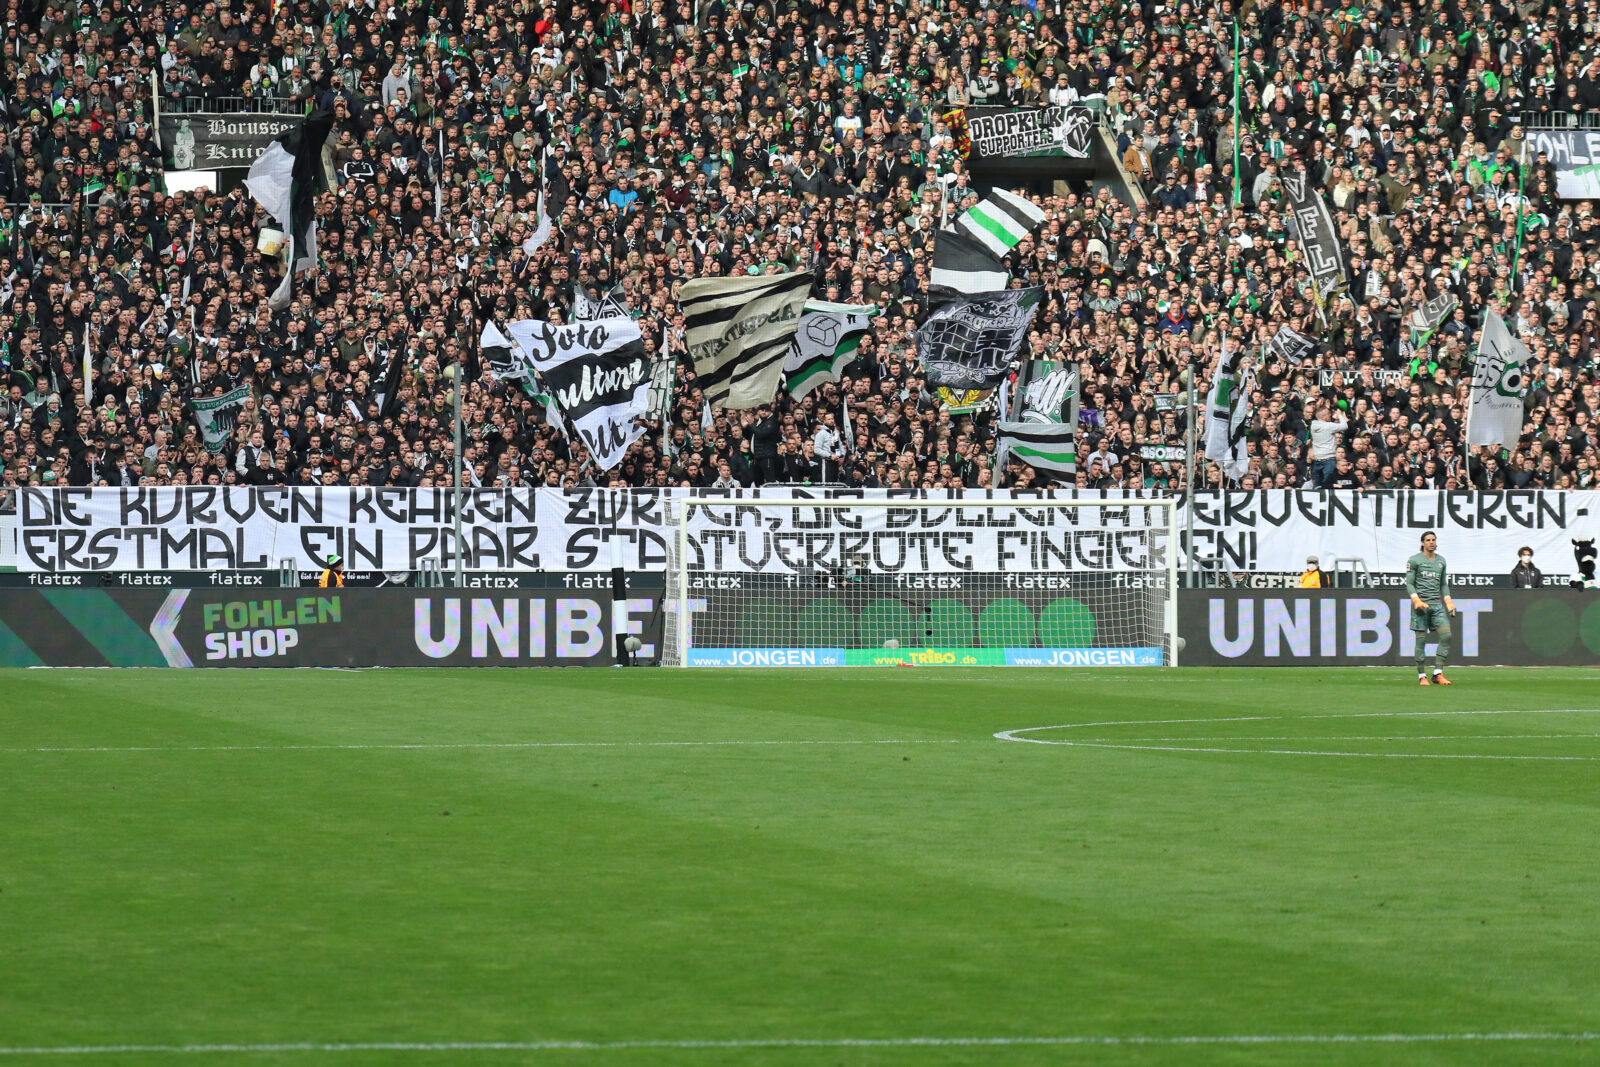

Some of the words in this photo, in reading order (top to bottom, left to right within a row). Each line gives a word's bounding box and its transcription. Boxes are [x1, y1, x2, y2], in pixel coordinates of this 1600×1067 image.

[206, 119, 296, 138] Borusse
[969, 107, 1061, 141] DROPKIK
[1322, 370, 1402, 386] MALHER
[22, 487, 92, 526] DIE
[120, 486, 322, 525] KURVEN
[349, 487, 535, 524] KEHREN
[791, 489, 864, 529] DIE
[886, 489, 1078, 529] BULLEN
[1100, 489, 1566, 529] HYPERVENTILIEREN
[23, 527, 267, 571] ERSTMAL
[300, 526, 382, 570] EIN
[409, 526, 540, 570] PAAR
[566, 527, 973, 572] STADTVERBOTE
[997, 530, 1257, 571] FINGIEREN!
[28, 574, 81, 585] flatex
[119, 574, 172, 585] flatex
[209, 573, 262, 585] flatex
[894, 574, 962, 588] flatex
[1004, 574, 1071, 588] flatex
[1113, 574, 1179, 588] flate
[203, 596, 341, 631] FOHLEN
[205, 628, 298, 660] SHOP
[727, 650, 816, 666] JONGEN
[1048, 650, 1135, 666] JONGEN
